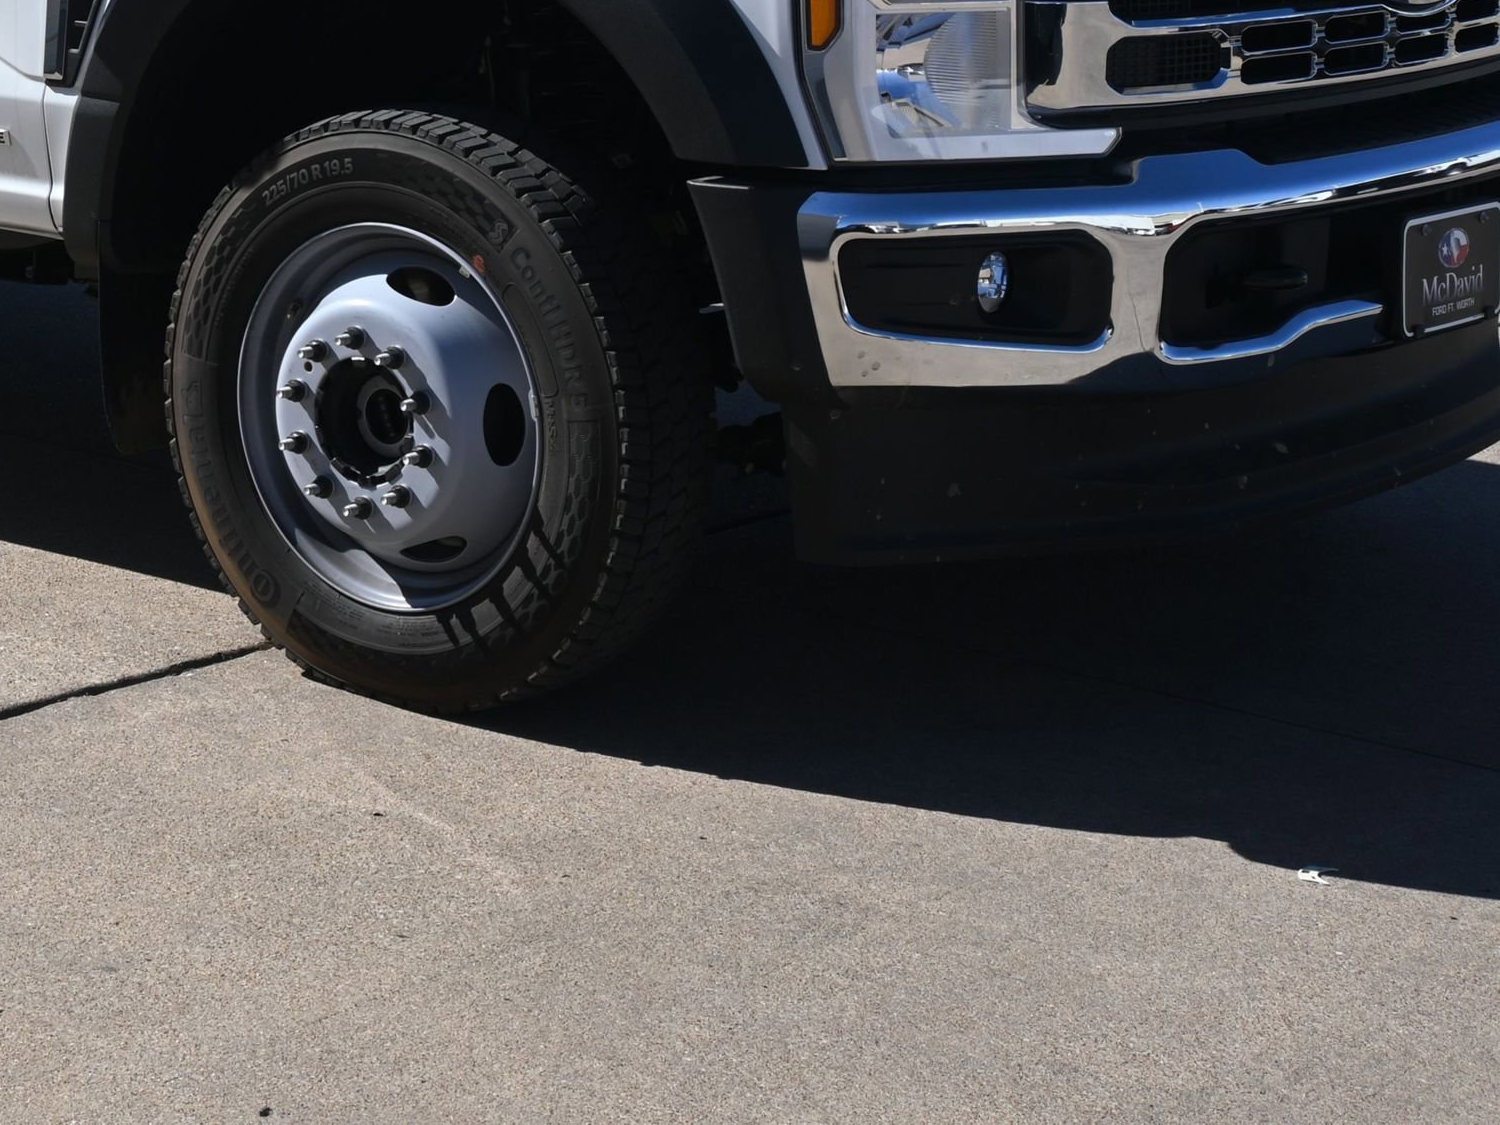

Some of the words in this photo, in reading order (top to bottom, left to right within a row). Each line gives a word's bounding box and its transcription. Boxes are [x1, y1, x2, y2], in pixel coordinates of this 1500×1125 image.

[262, 168, 309, 207] 225/70
[311, 163, 323, 181] R
[323, 158, 354, 177] 19.5
[1422, 263, 1484, 308] McDavid
[1432, 304, 1447, 316] FORD
[1456, 297, 1476, 310] WORTH
